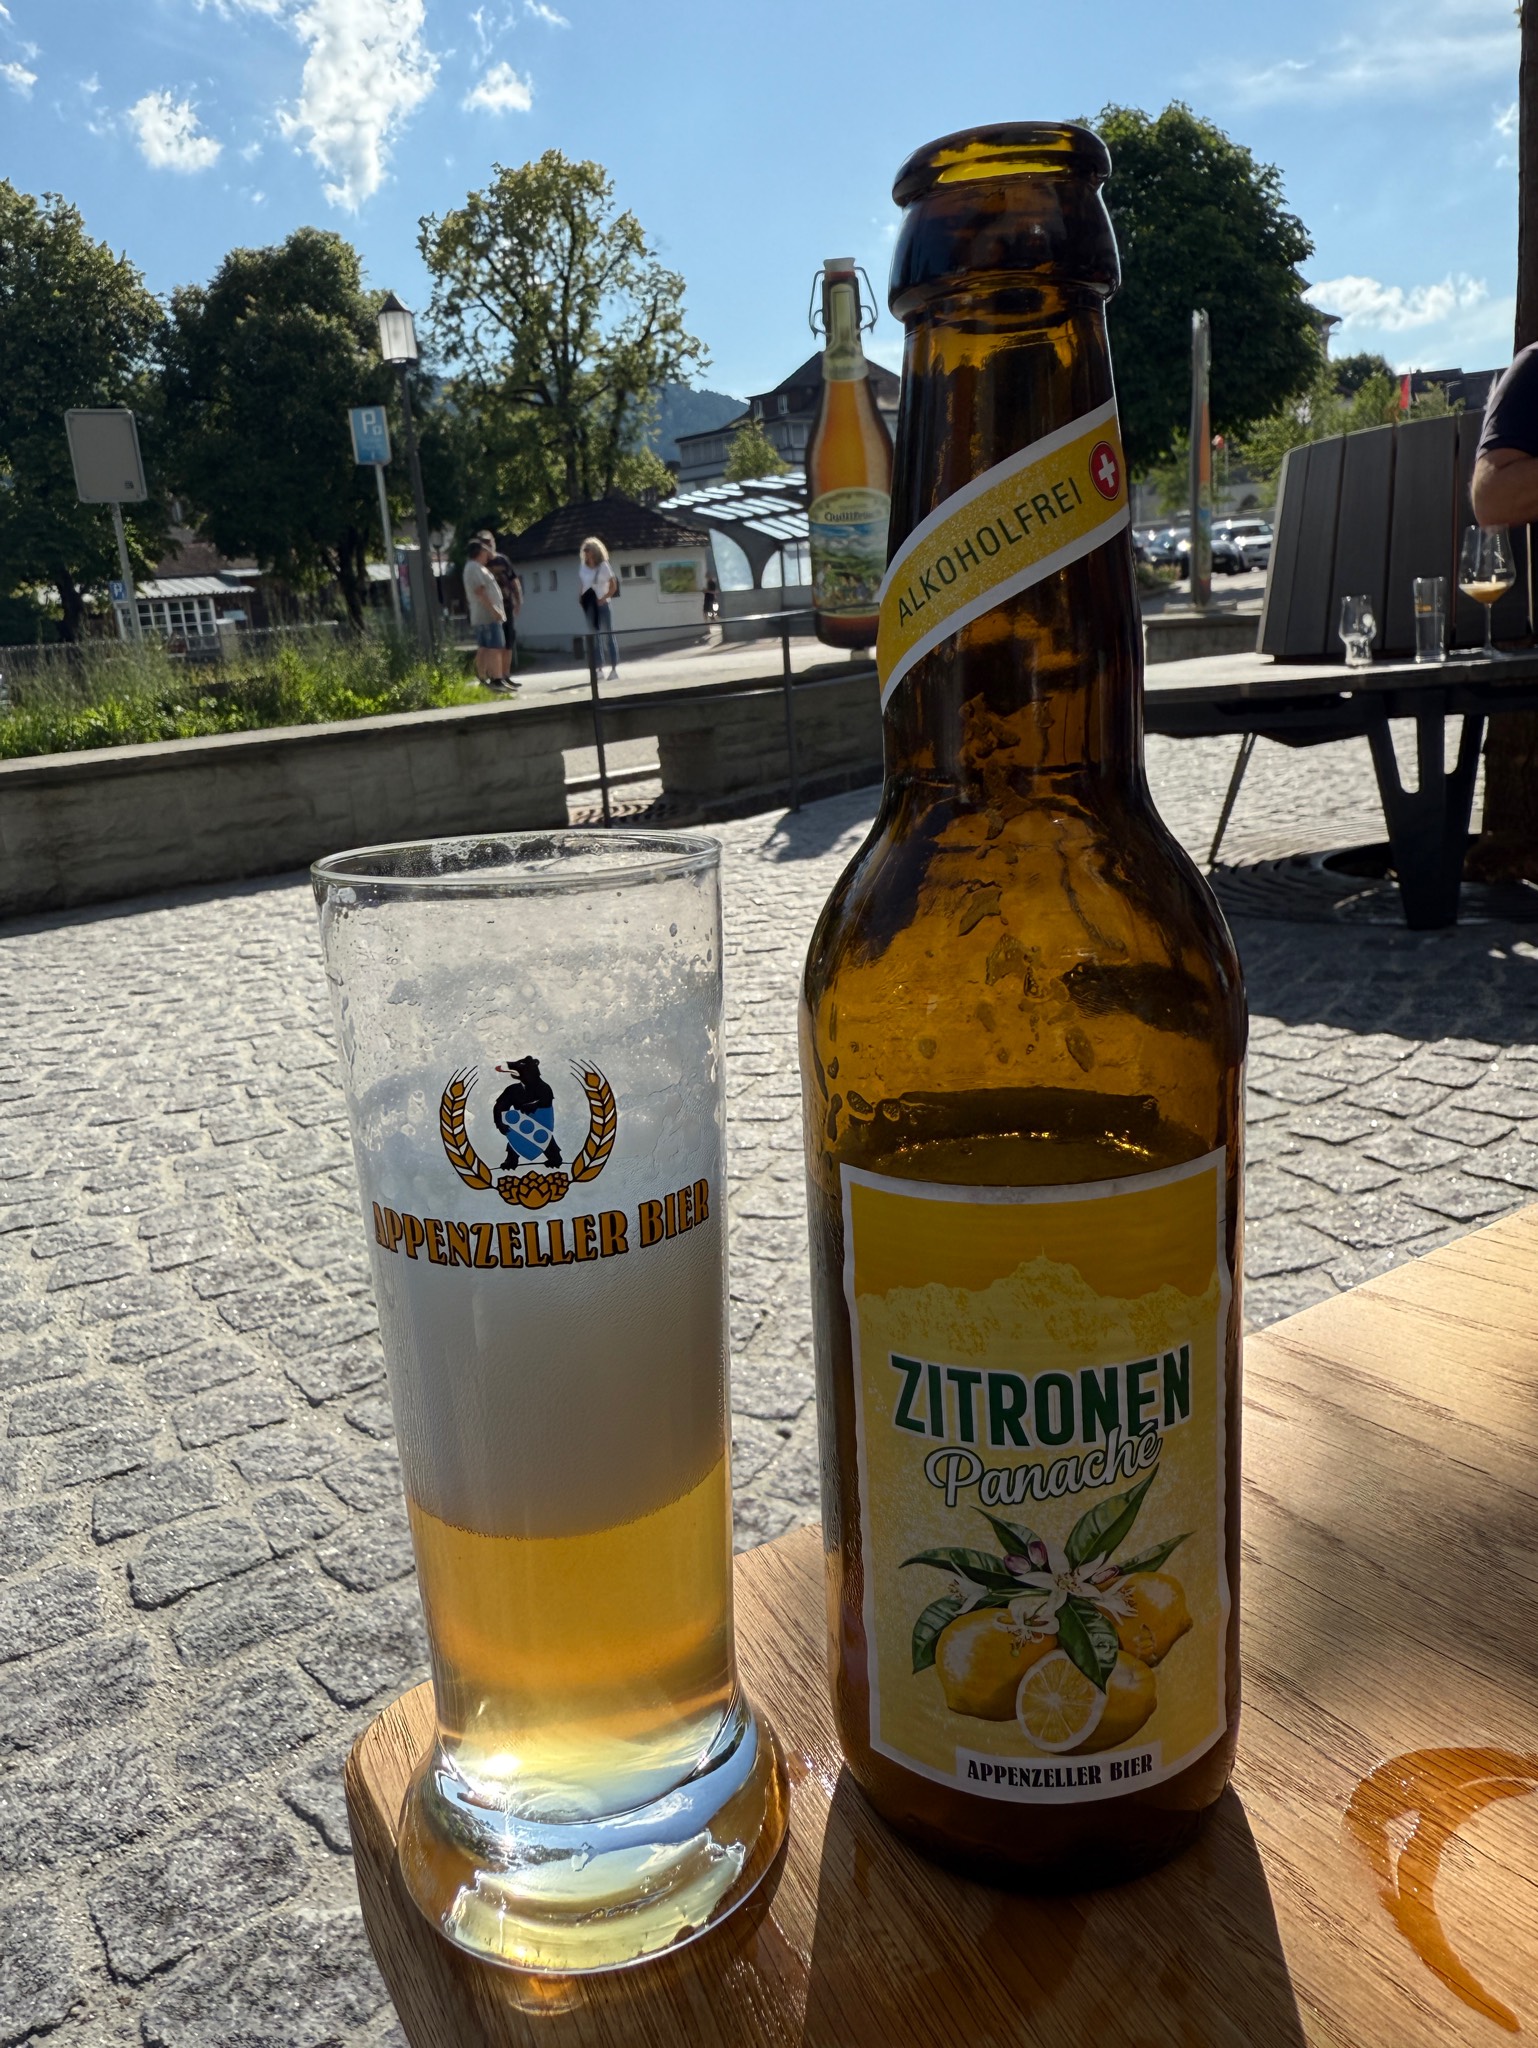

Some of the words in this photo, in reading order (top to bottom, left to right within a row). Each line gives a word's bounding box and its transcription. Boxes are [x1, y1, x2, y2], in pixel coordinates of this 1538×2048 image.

[899, 477, 1082, 627] ALKOHOLFREI
[372, 1201, 629, 1269] APPENZELLER
[638, 1178, 709, 1248] BIER
[889, 1344, 1191, 1448] ZITRONEN
[923, 1419, 1163, 1508] Panaché
[967, 1759, 1102, 1788] APPENZELLER
[1110, 1753, 1153, 1782] BIER
